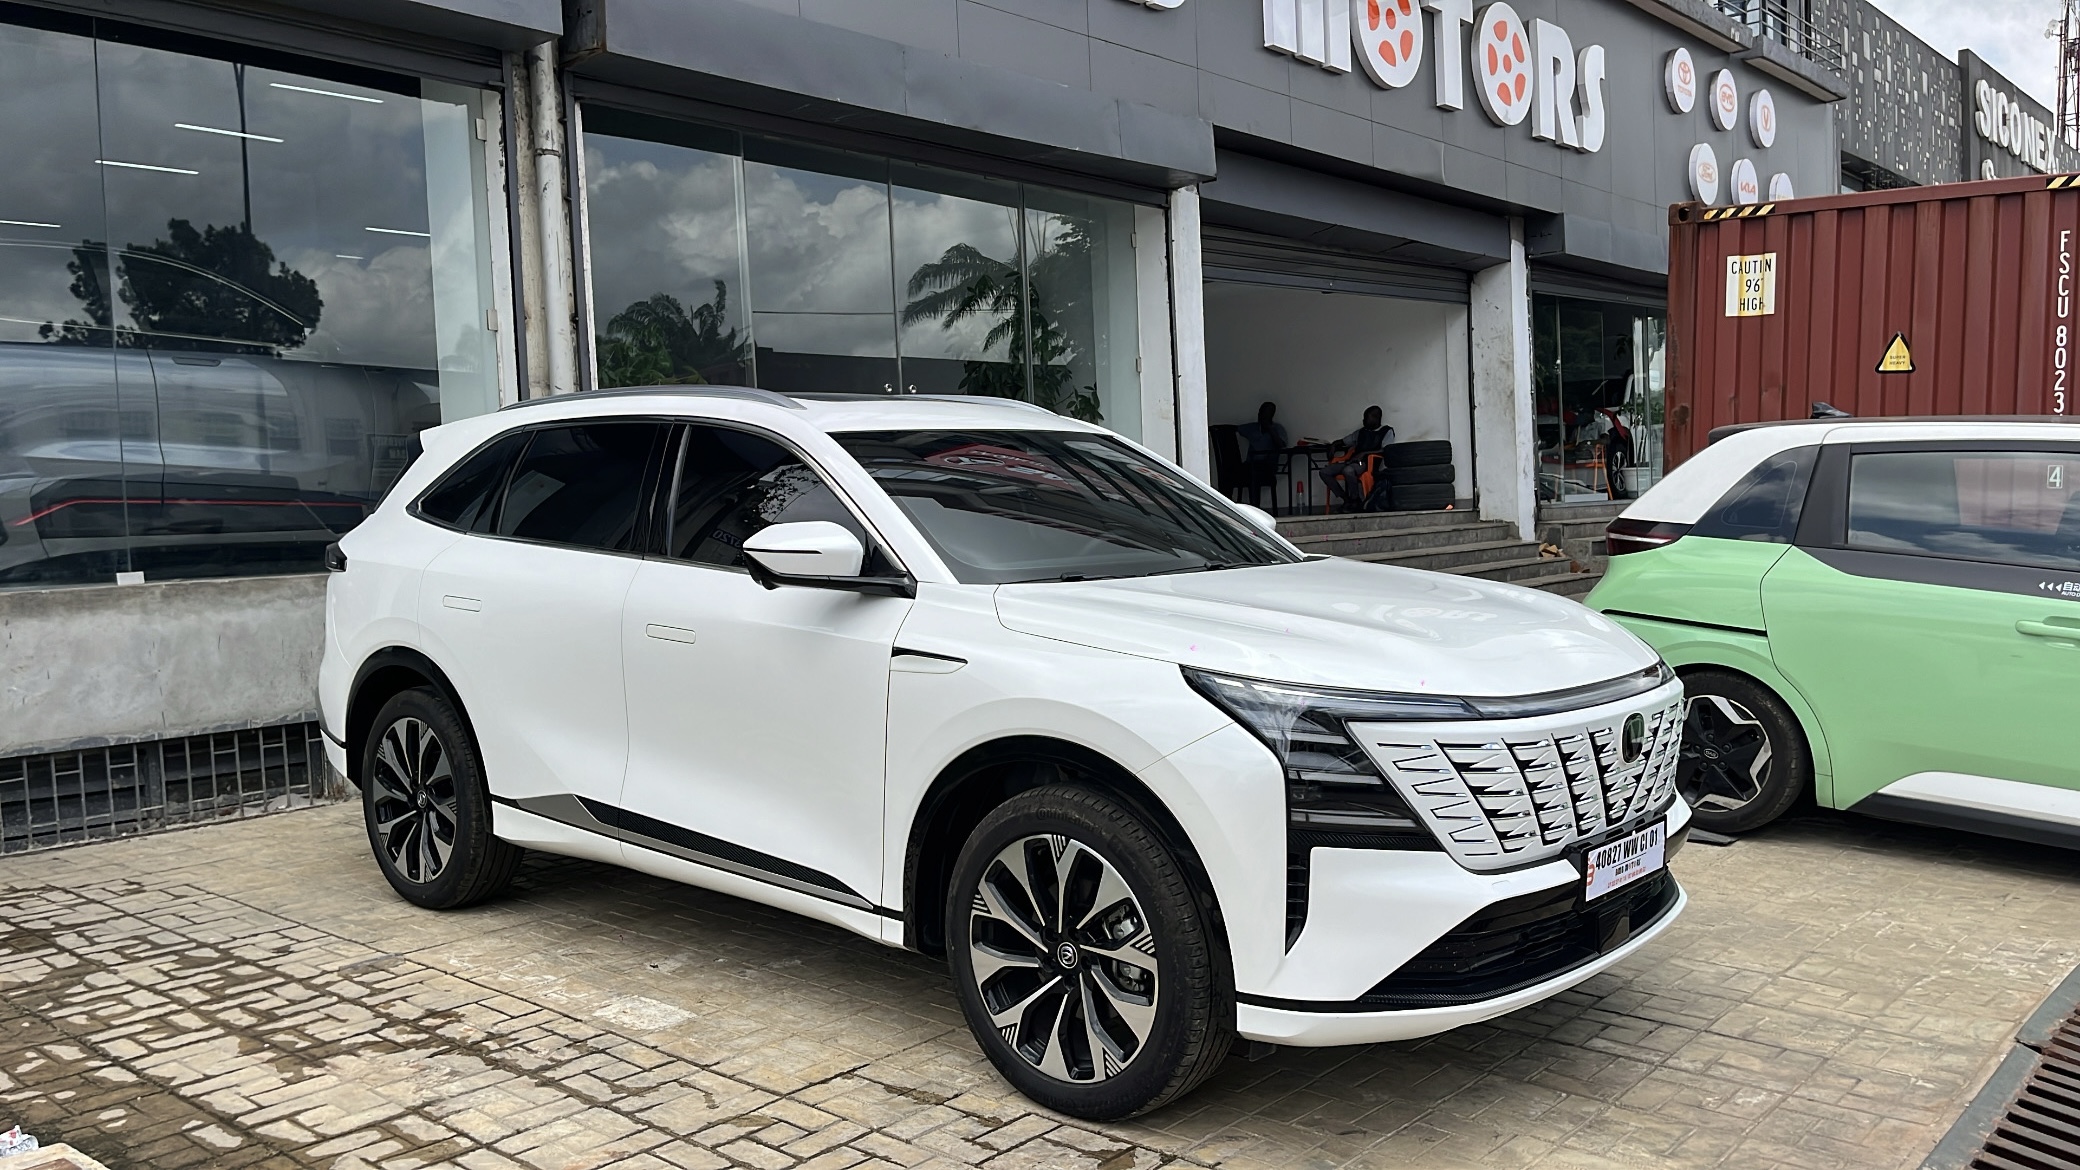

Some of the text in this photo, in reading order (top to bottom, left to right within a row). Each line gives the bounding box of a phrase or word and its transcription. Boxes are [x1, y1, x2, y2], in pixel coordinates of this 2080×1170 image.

[1974, 79, 2057, 175] SICONEX
[2053, 230, 2071, 416] FSCU 8023
[2049, 466, 2061, 487] 4
[1595, 843, 1622, 870] 40827
[1623, 836, 1639, 859] WW
[1649, 828, 1658, 848] 01
